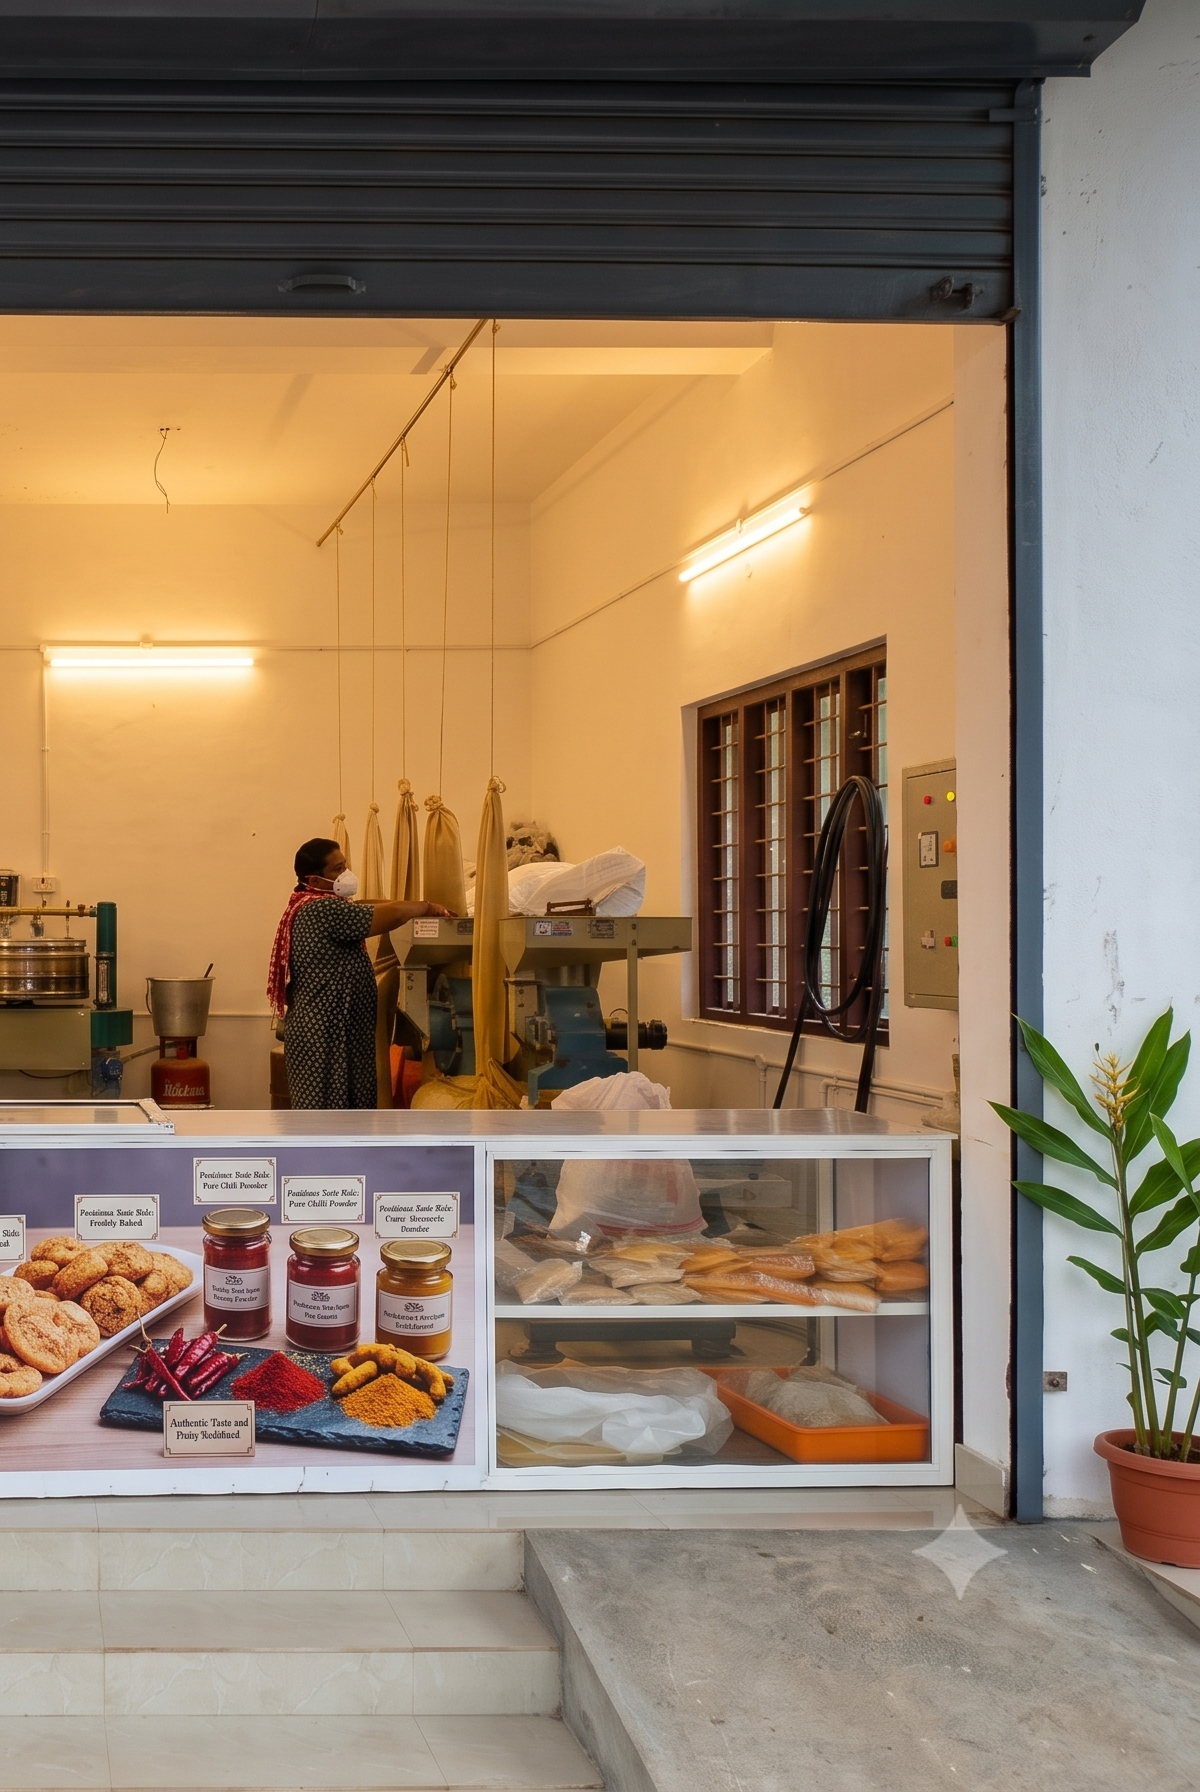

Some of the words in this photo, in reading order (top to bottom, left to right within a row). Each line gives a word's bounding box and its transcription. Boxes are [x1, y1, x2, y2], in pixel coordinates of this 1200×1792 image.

[170, 1418, 208, 1428] Authentic
[210, 1418, 232, 1427] Taste
[234, 1418, 249, 1427] and
